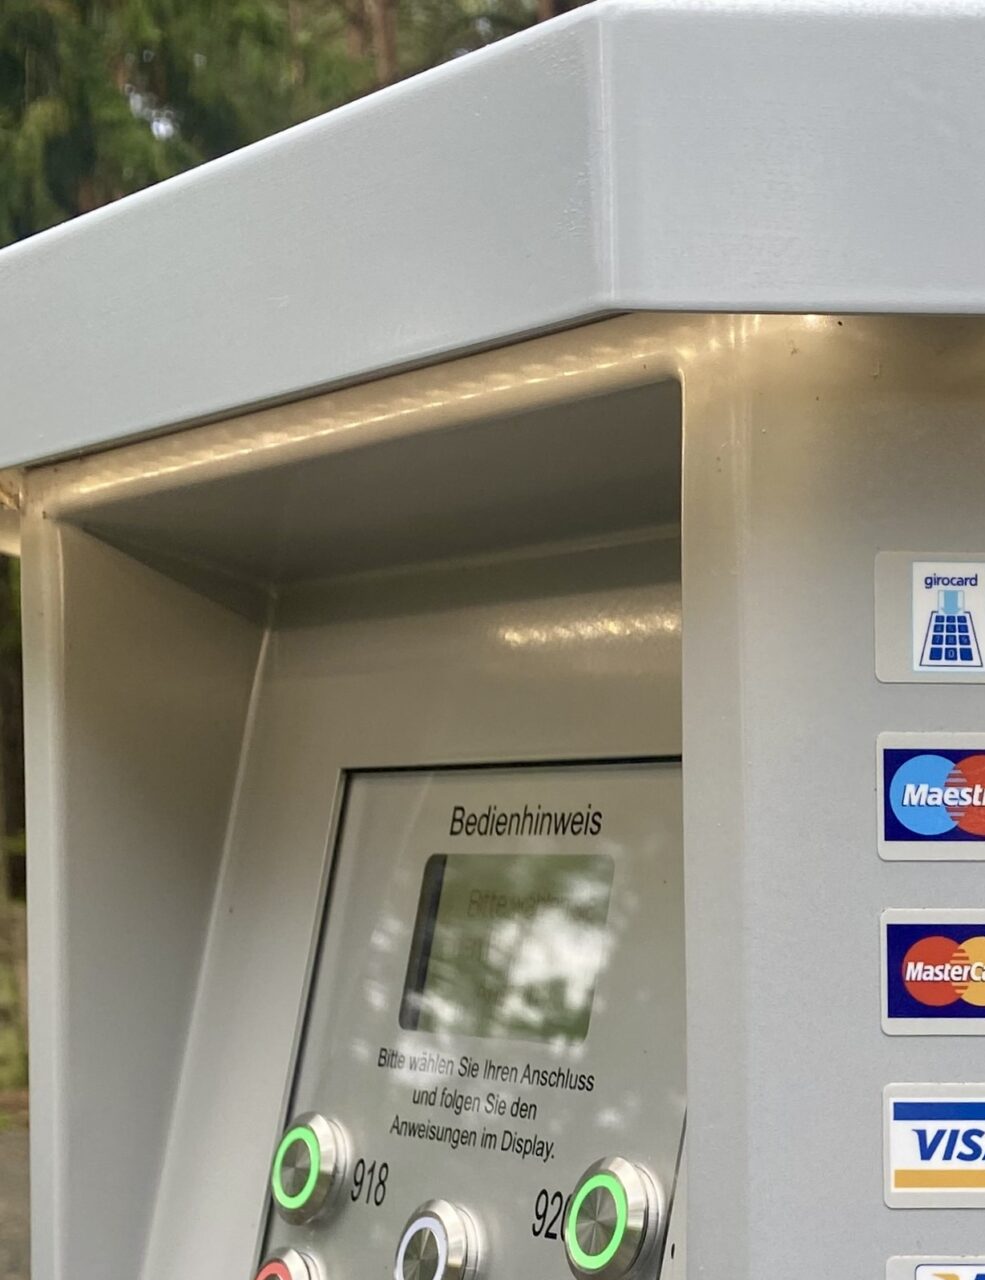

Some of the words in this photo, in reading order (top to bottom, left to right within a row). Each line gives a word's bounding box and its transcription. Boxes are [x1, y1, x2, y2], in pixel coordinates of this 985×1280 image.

[923, 573, 979, 590] girocard
[449, 804, 603, 837] Bedienhinweis
[377, 1047, 405, 1070] Bitte
[408, 1052, 454, 1076] wählen
[457, 1055, 480, 1079] Sie
[483, 1059, 519, 1083] Ihren
[520, 1063, 596, 1092] Anschluss
[412, 1088, 437, 1107] und
[439, 1088, 481, 1117] folgen
[484, 1093, 507, 1116] Sie
[510, 1097, 538, 1120] den
[389, 1114, 477, 1149] Anweisungen
[480, 1129, 497, 1151] im
[500, 1130, 556, 1160] Display.
[350, 1158, 389, 1206] 918
